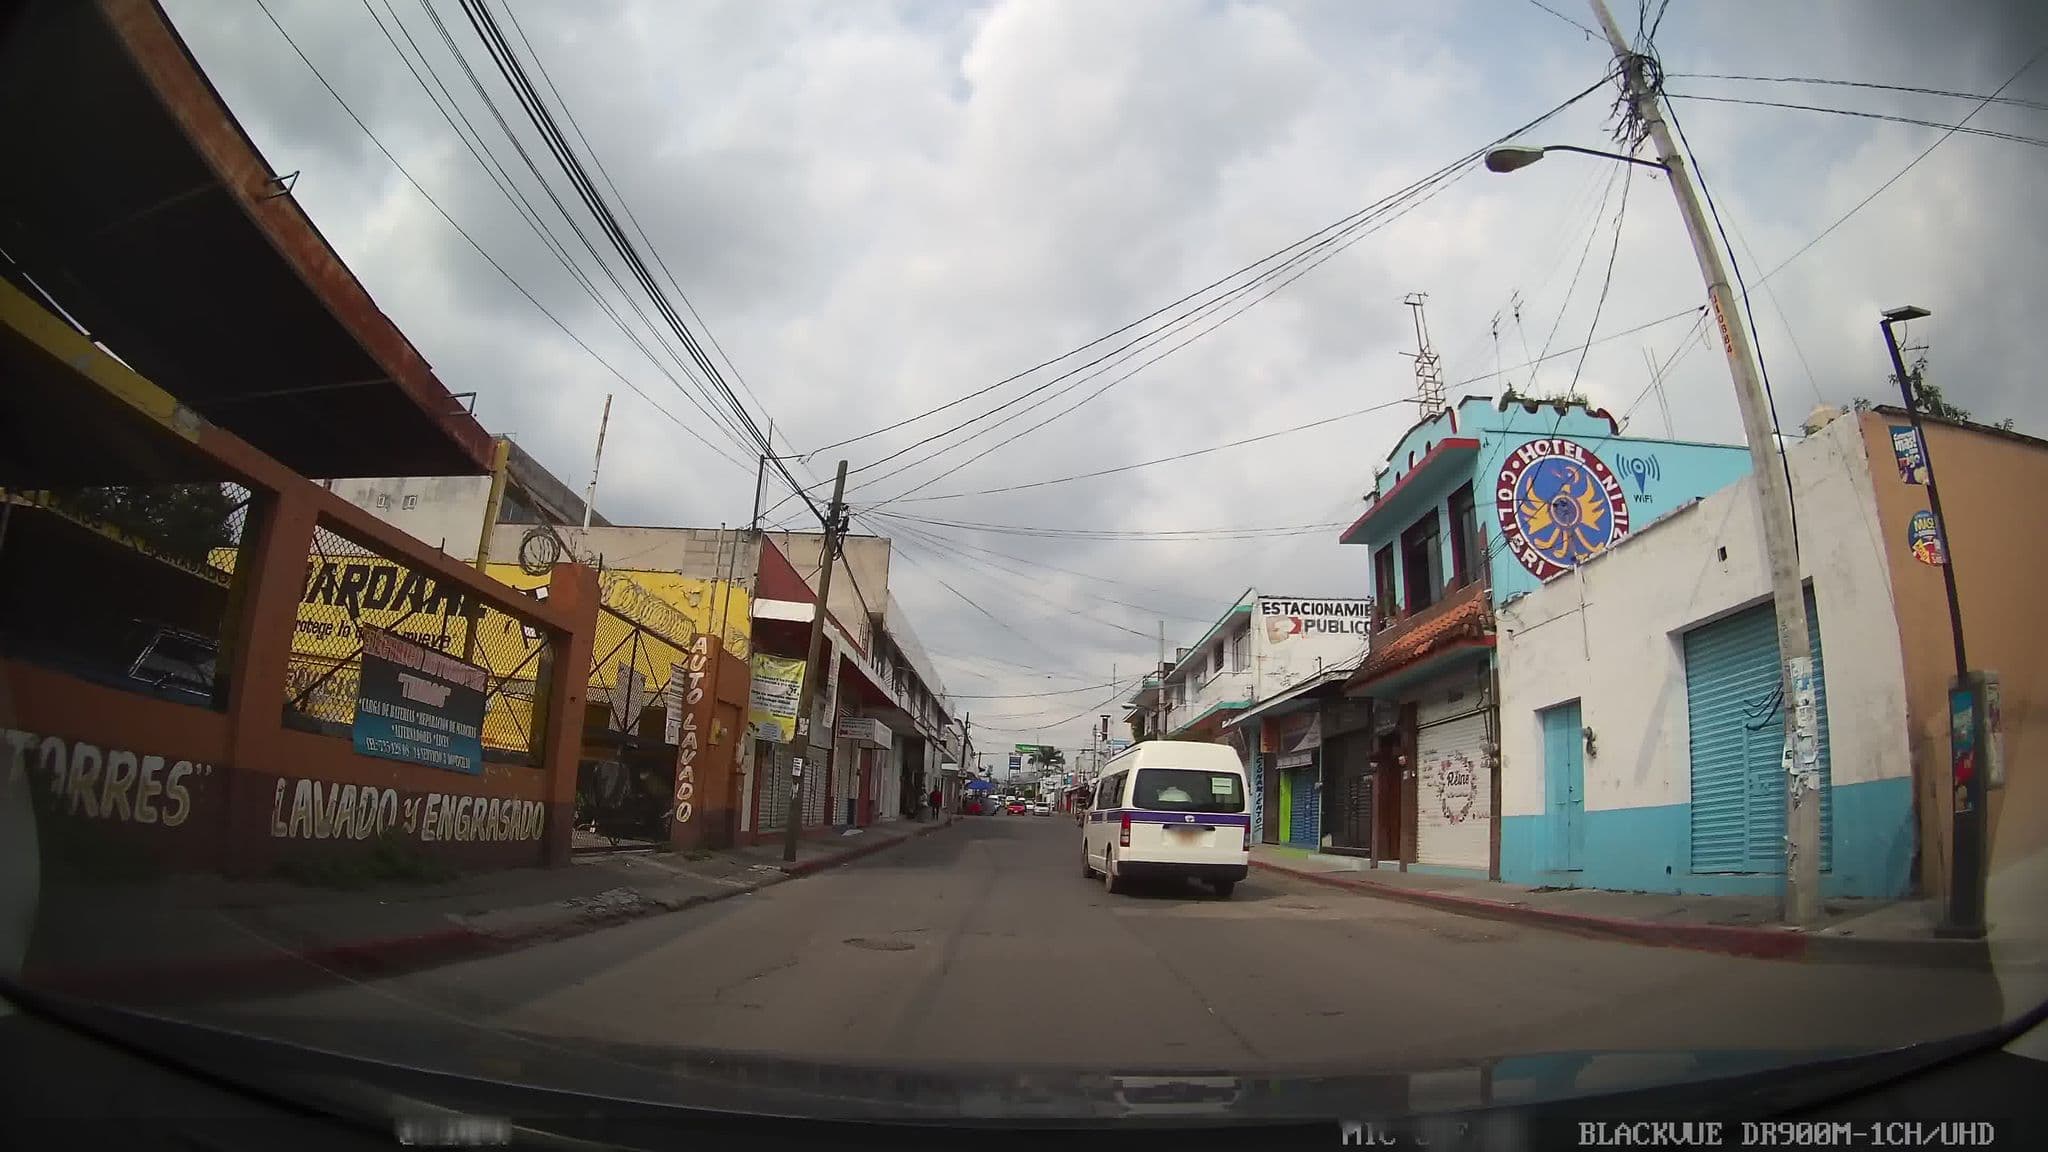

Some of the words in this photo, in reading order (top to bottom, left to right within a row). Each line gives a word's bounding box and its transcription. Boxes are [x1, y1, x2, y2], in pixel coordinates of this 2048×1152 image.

[1517, 440, 1586, 464] HOTEL
[1498, 471, 1545, 575] COLIBRI
[1602, 475, 1630, 541] ZILIN
[296, 620, 333, 639] rotege
[687, 637, 707, 705] AUTO
[676, 713, 698, 823] LAVADO
[271, 777, 398, 841] LAVADO
[420, 793, 545, 842] ENGRASADO
